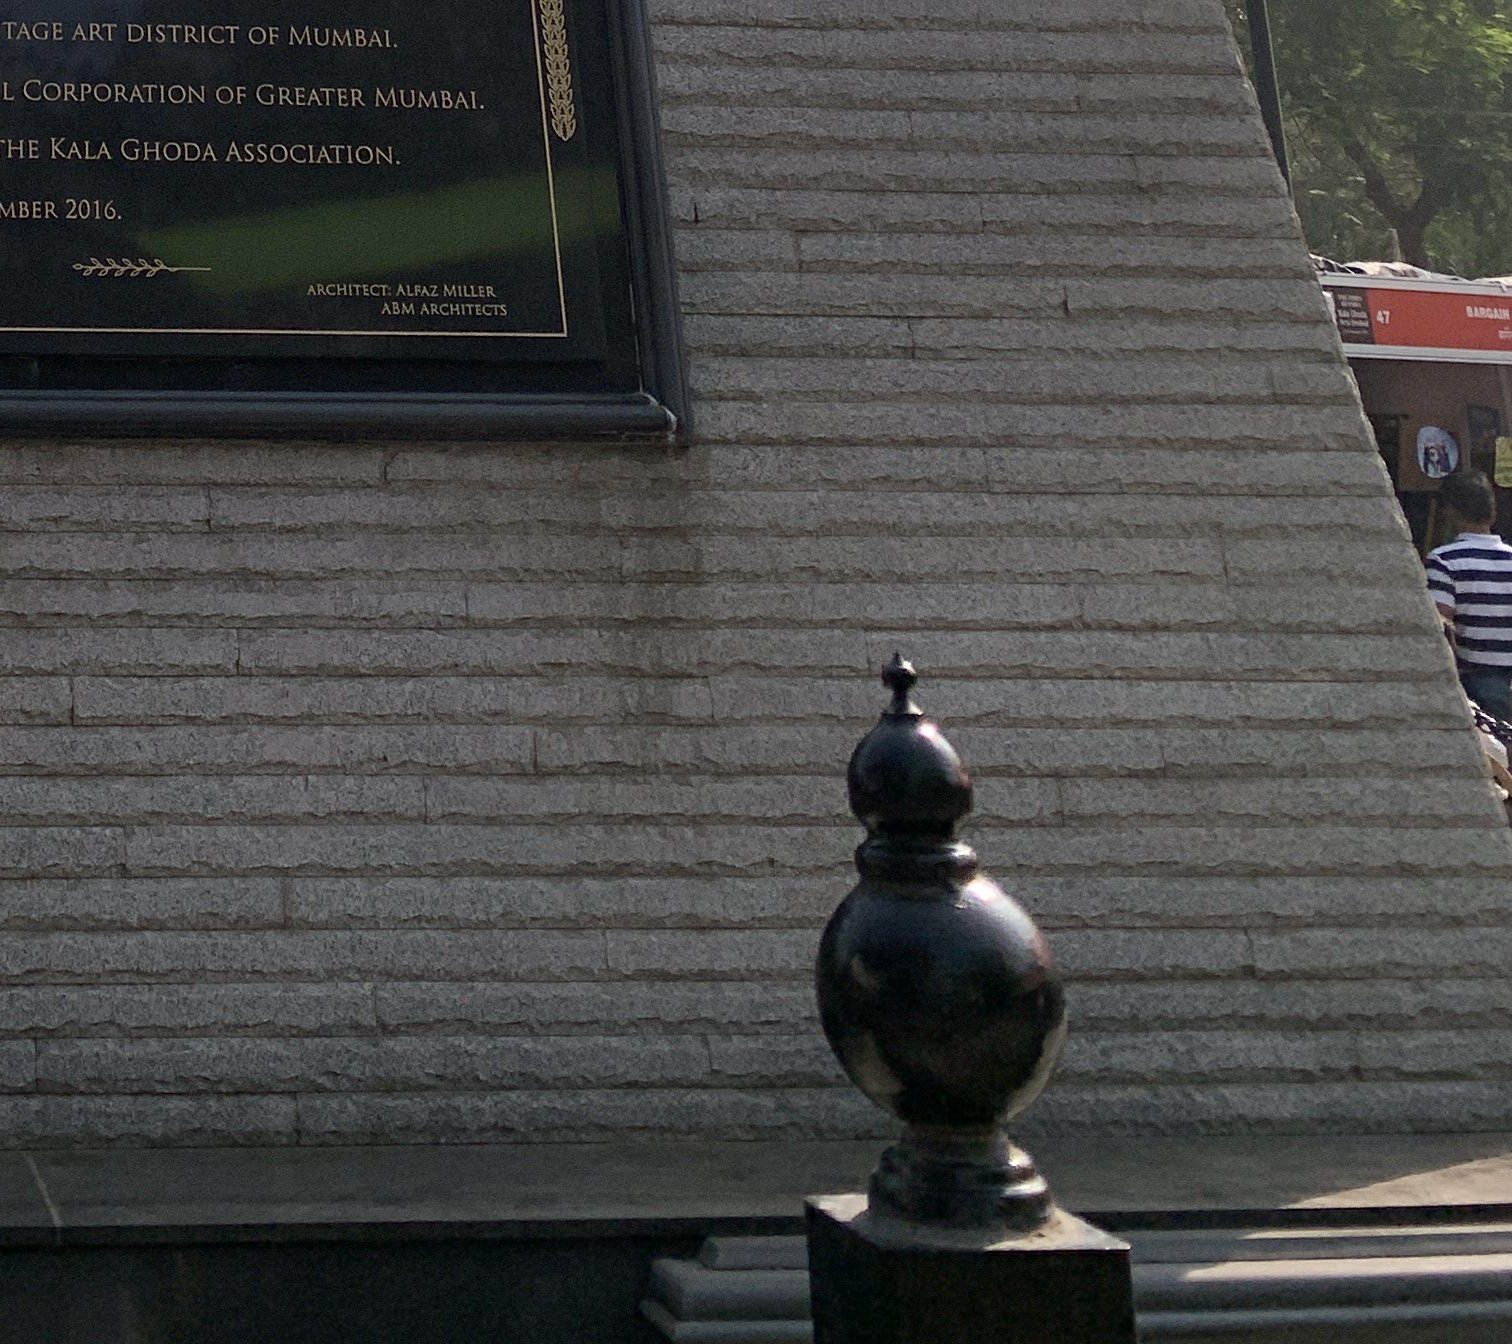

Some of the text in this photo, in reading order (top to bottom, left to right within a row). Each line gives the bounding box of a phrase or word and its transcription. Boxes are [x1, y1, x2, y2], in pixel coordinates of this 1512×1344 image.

[71, 22, 118, 42] ART
[126, 23, 240, 45] DISTRICT
[248, 26, 280, 46] OF
[288, 25, 399, 48] MUMBAI.
[23, 78, 206, 104] CORPORATION
[215, 85, 247, 105] OF
[255, 83, 366, 108] GREATER
[374, 86, 485, 110] MUMBAI.
[50, 136, 113, 160] KALA
[120, 138, 218, 162] GHODA
[225, 140, 401, 165] ASSOCIATION.
[65, 198, 122, 220] 2016.
[307, 283, 497, 298] ARCHITECT: ALFAZ MILLER
[380, 301, 508, 317] ABM ARCHITECTS
[1376, 310, 1390, 325] 47
[1465, 305, 1511, 321] BARGAIN
